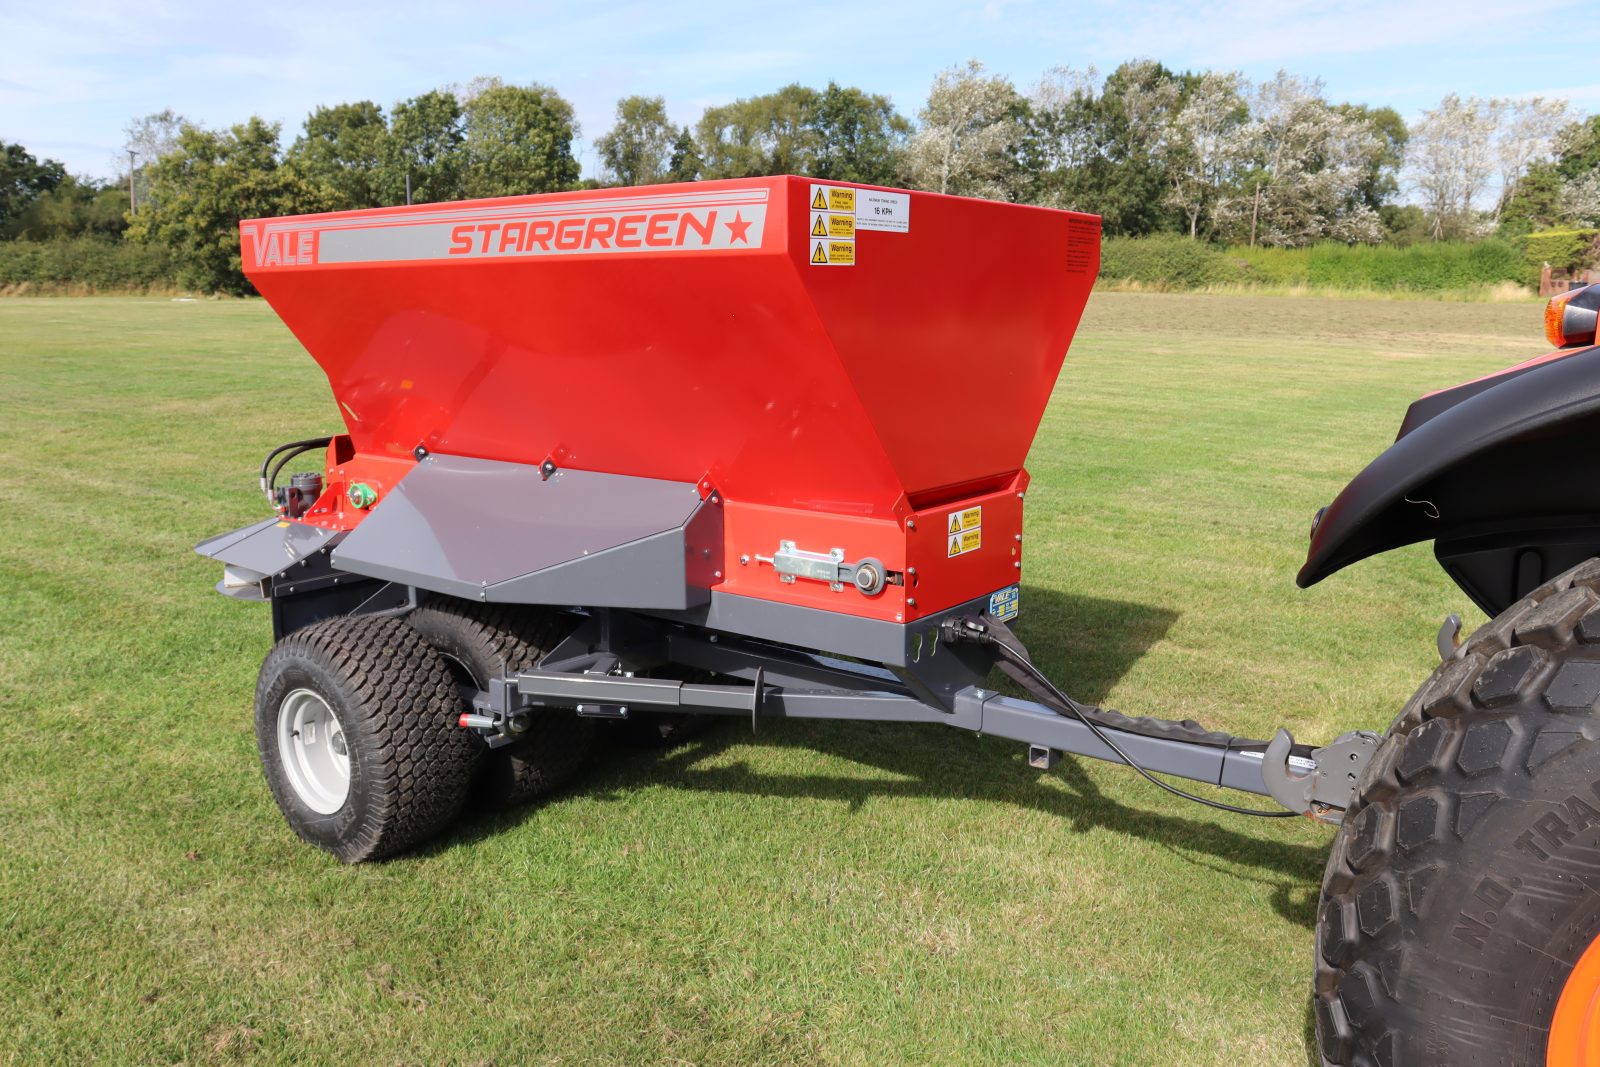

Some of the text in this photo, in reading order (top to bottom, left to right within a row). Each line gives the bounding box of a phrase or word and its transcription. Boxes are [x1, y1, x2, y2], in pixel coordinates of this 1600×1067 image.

[831, 190, 852, 200] Warning
[874, 206, 892, 216] 16 KPH
[831, 217, 852, 228] Warning
[448, 210, 718, 255] STARGREEN
[242, 225, 314, 267] VALE
[831, 243, 852, 253] Warning
[1512, 778, 1600, 863] TRA
